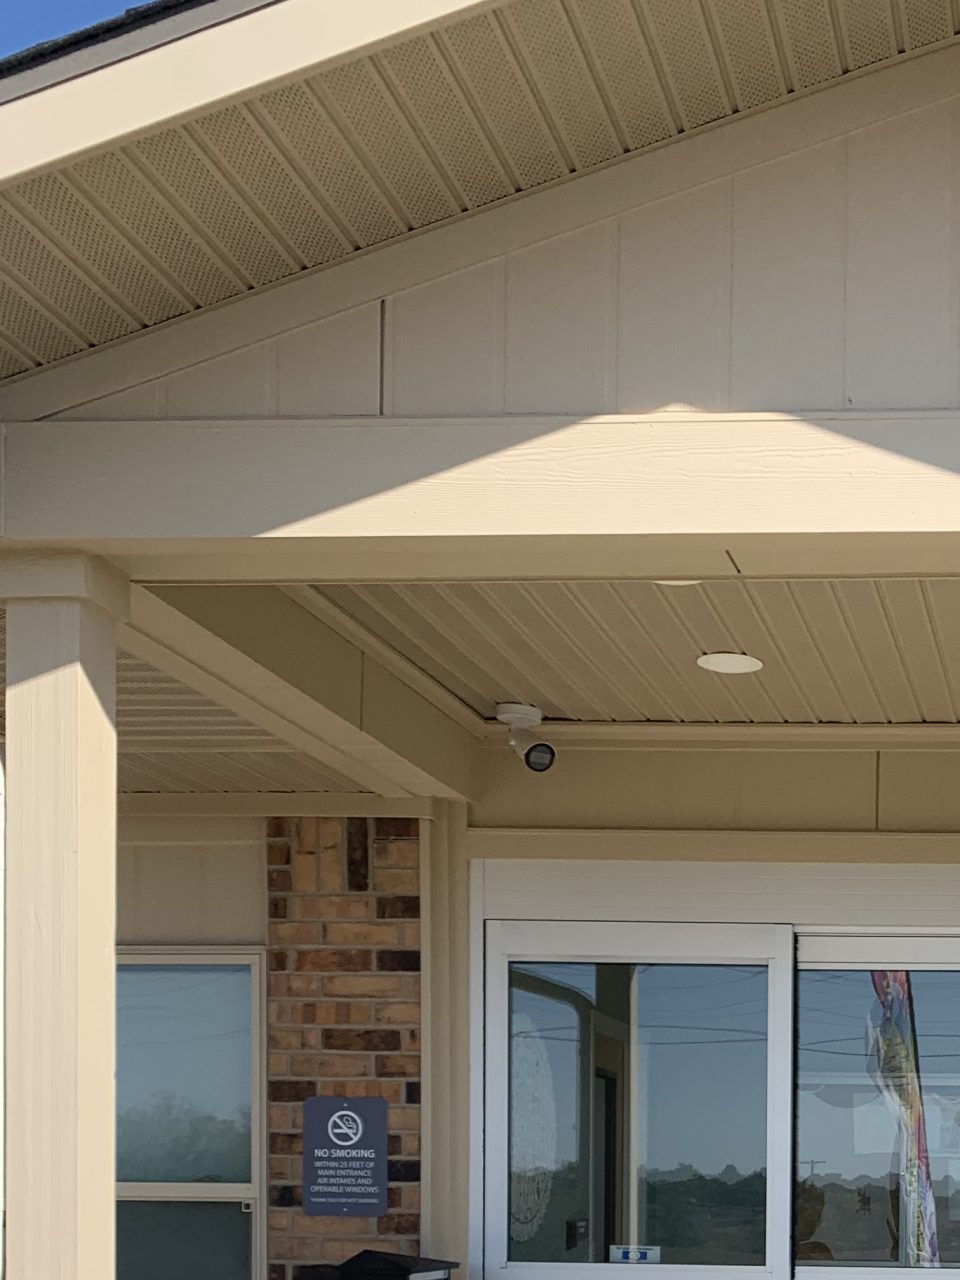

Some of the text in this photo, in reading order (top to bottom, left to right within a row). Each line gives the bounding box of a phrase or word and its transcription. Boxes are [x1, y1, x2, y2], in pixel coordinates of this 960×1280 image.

[314, 1148, 375, 1159] NO SMOKING
[349, 1161, 364, 1169] FEET
[365, 1161, 375, 1169] OF
[336, 1169, 372, 1177] ENTRANCE
[329, 1177, 356, 1185] INTAKES
[357, 1177, 372, 1185] AND
[310, 1185, 344, 1193] OPERABLE
